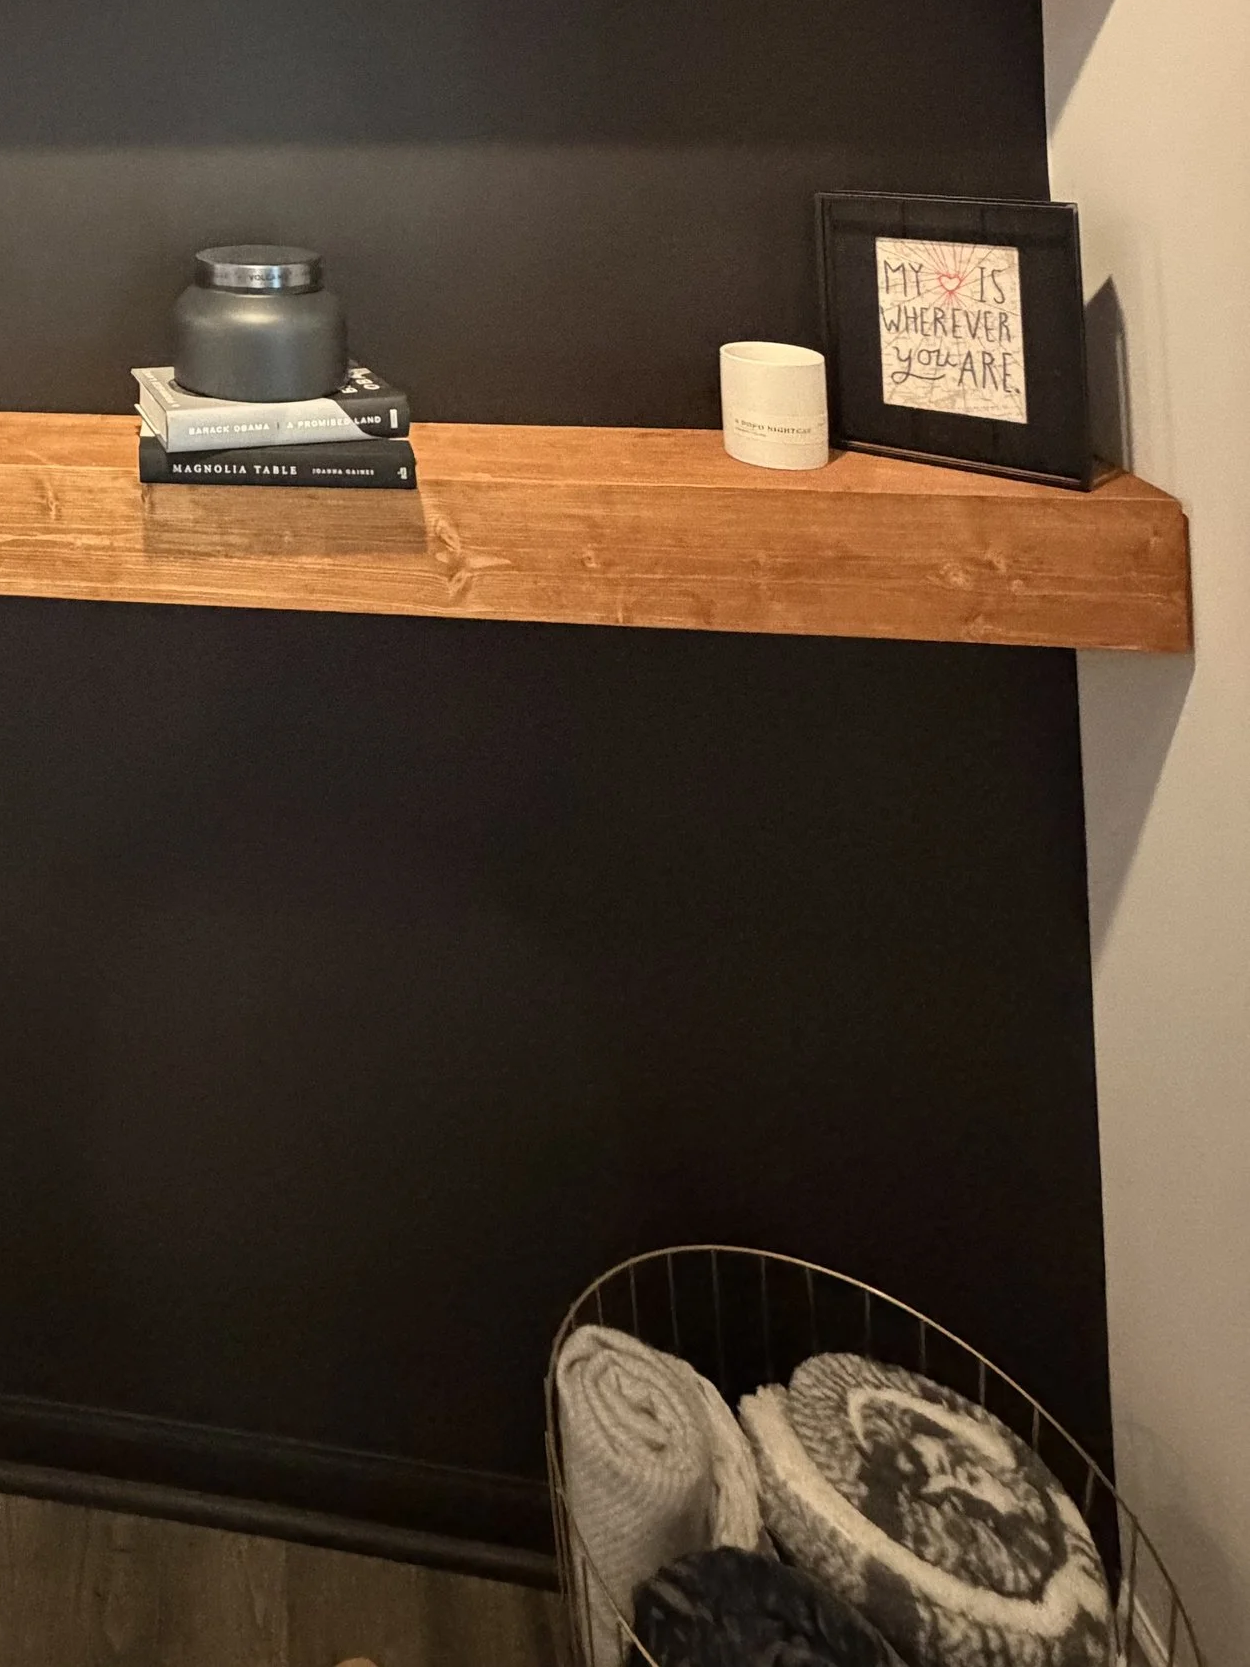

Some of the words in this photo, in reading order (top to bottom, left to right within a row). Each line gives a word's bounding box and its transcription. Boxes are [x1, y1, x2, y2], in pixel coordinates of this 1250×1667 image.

[883, 260, 924, 297] MY
[979, 266, 1007, 304] IS
[881, 305, 1011, 343] WHEREVER
[957, 350, 1020, 395] ARE.
[188, 424, 230, 435] BARACK
[233, 422, 270, 433] OBAMA
[286, 421, 294, 429] A
[297, 416, 351, 428] PROMISED
[353, 415, 382, 425] LAND
[172, 463, 247, 475] MAGNOLIA
[253, 464, 298, 476] TABLE
[311, 467, 343, 475] JOANNA
